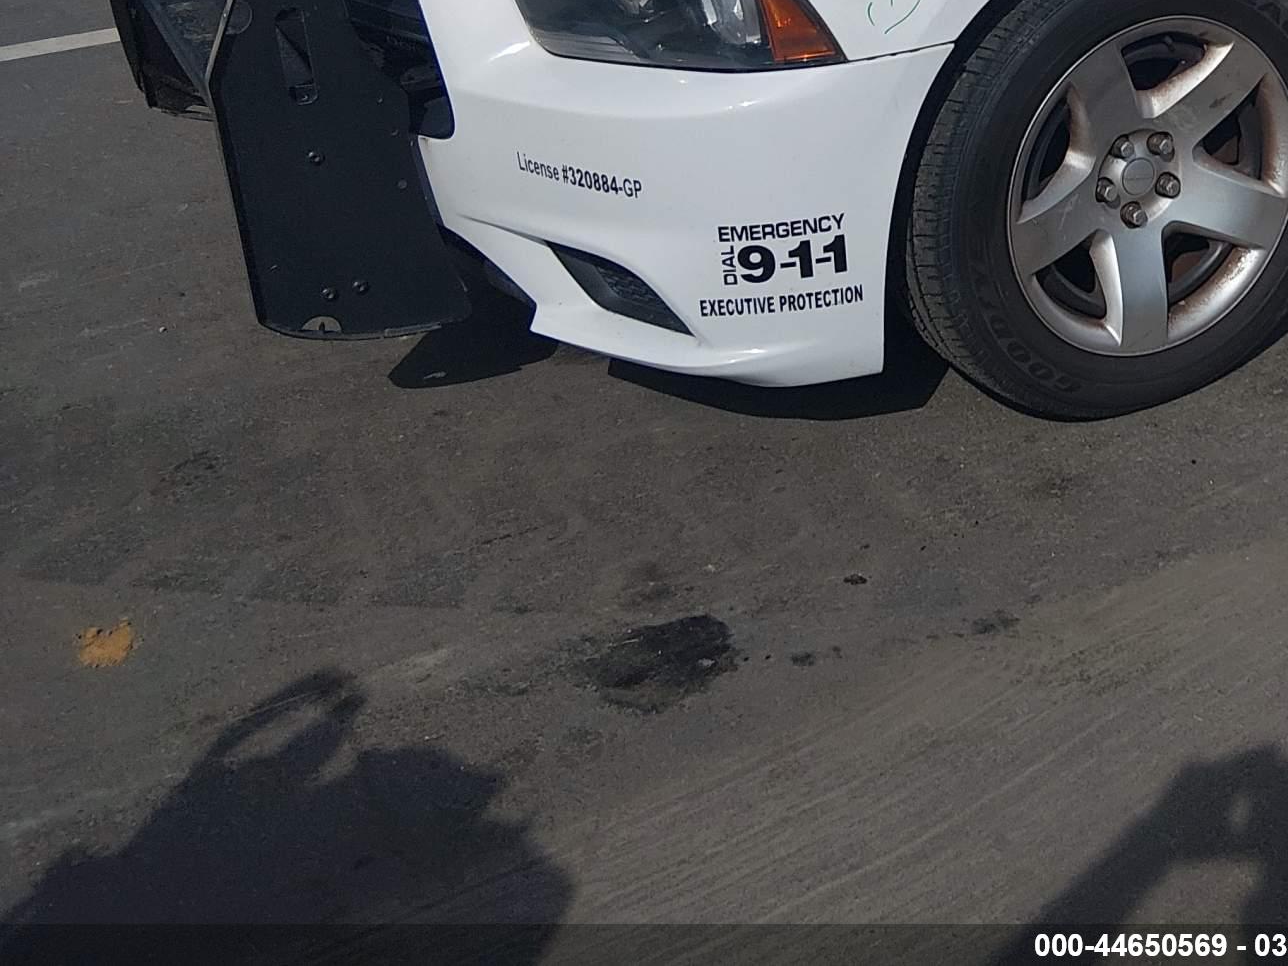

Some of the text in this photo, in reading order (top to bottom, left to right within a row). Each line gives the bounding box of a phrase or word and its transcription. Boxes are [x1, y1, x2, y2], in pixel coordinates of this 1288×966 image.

[516, 150, 643, 199] License #320884-GP
[718, 213, 845, 242] EMERGENCY
[721, 245, 738, 285] DIAL
[737, 234, 848, 284] 9-1-1
[700, 284, 864, 317] EXECUTIVE PROTECTION
